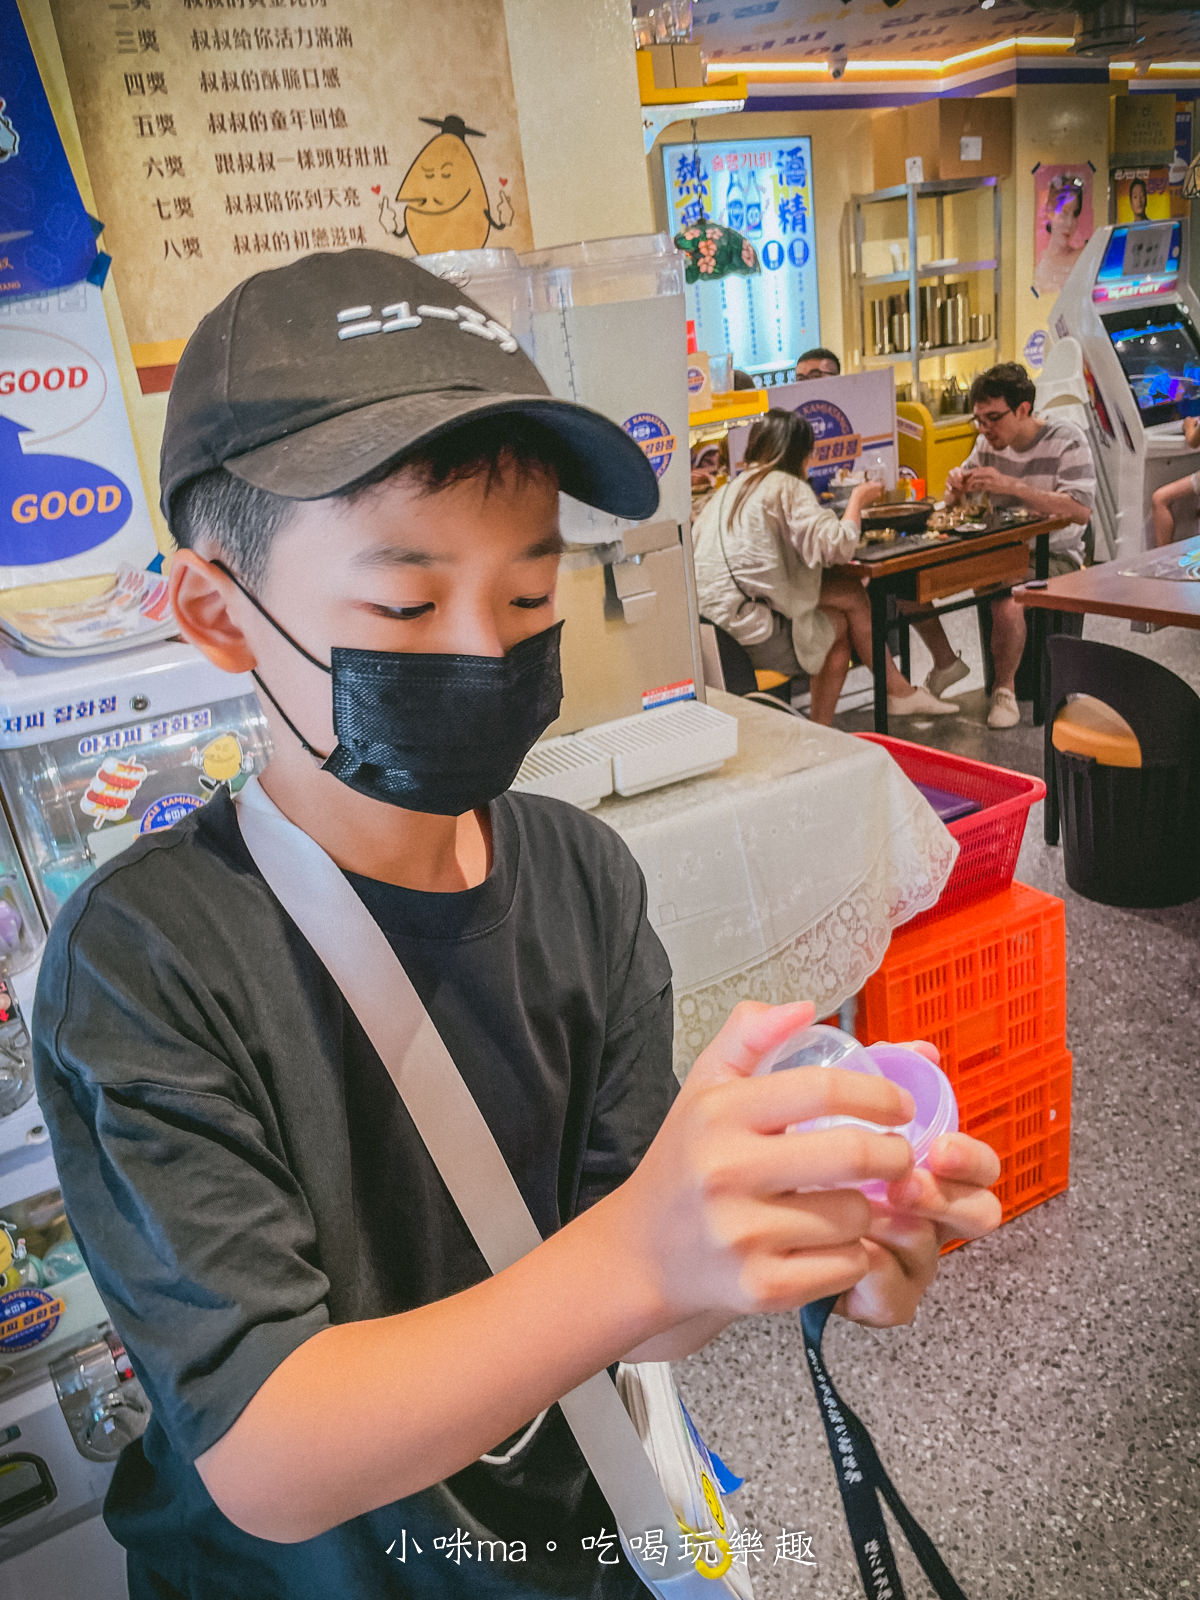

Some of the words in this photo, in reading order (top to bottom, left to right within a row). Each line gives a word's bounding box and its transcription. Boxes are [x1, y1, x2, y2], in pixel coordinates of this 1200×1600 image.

[115, 28, 161, 54] 三獎
[190, 25, 353, 50] 叔叔給你活力滿滿
[124, 71, 168, 97] 四獎
[200, 66, 341, 93] 叔叔的酥脆口感
[133, 113, 177, 139] 五獎
[207, 107, 349, 134] 叔叔的童年回憶
[143, 154, 186, 179] 六獎
[152, 196, 194, 220] 七獎
[224, 186, 361, 215] 叔叔陪你到天亮
[164, 234, 203, 261] 八獎
[0, 366, 89, 395] GOOD
[12, 485, 122, 524] GOOD
